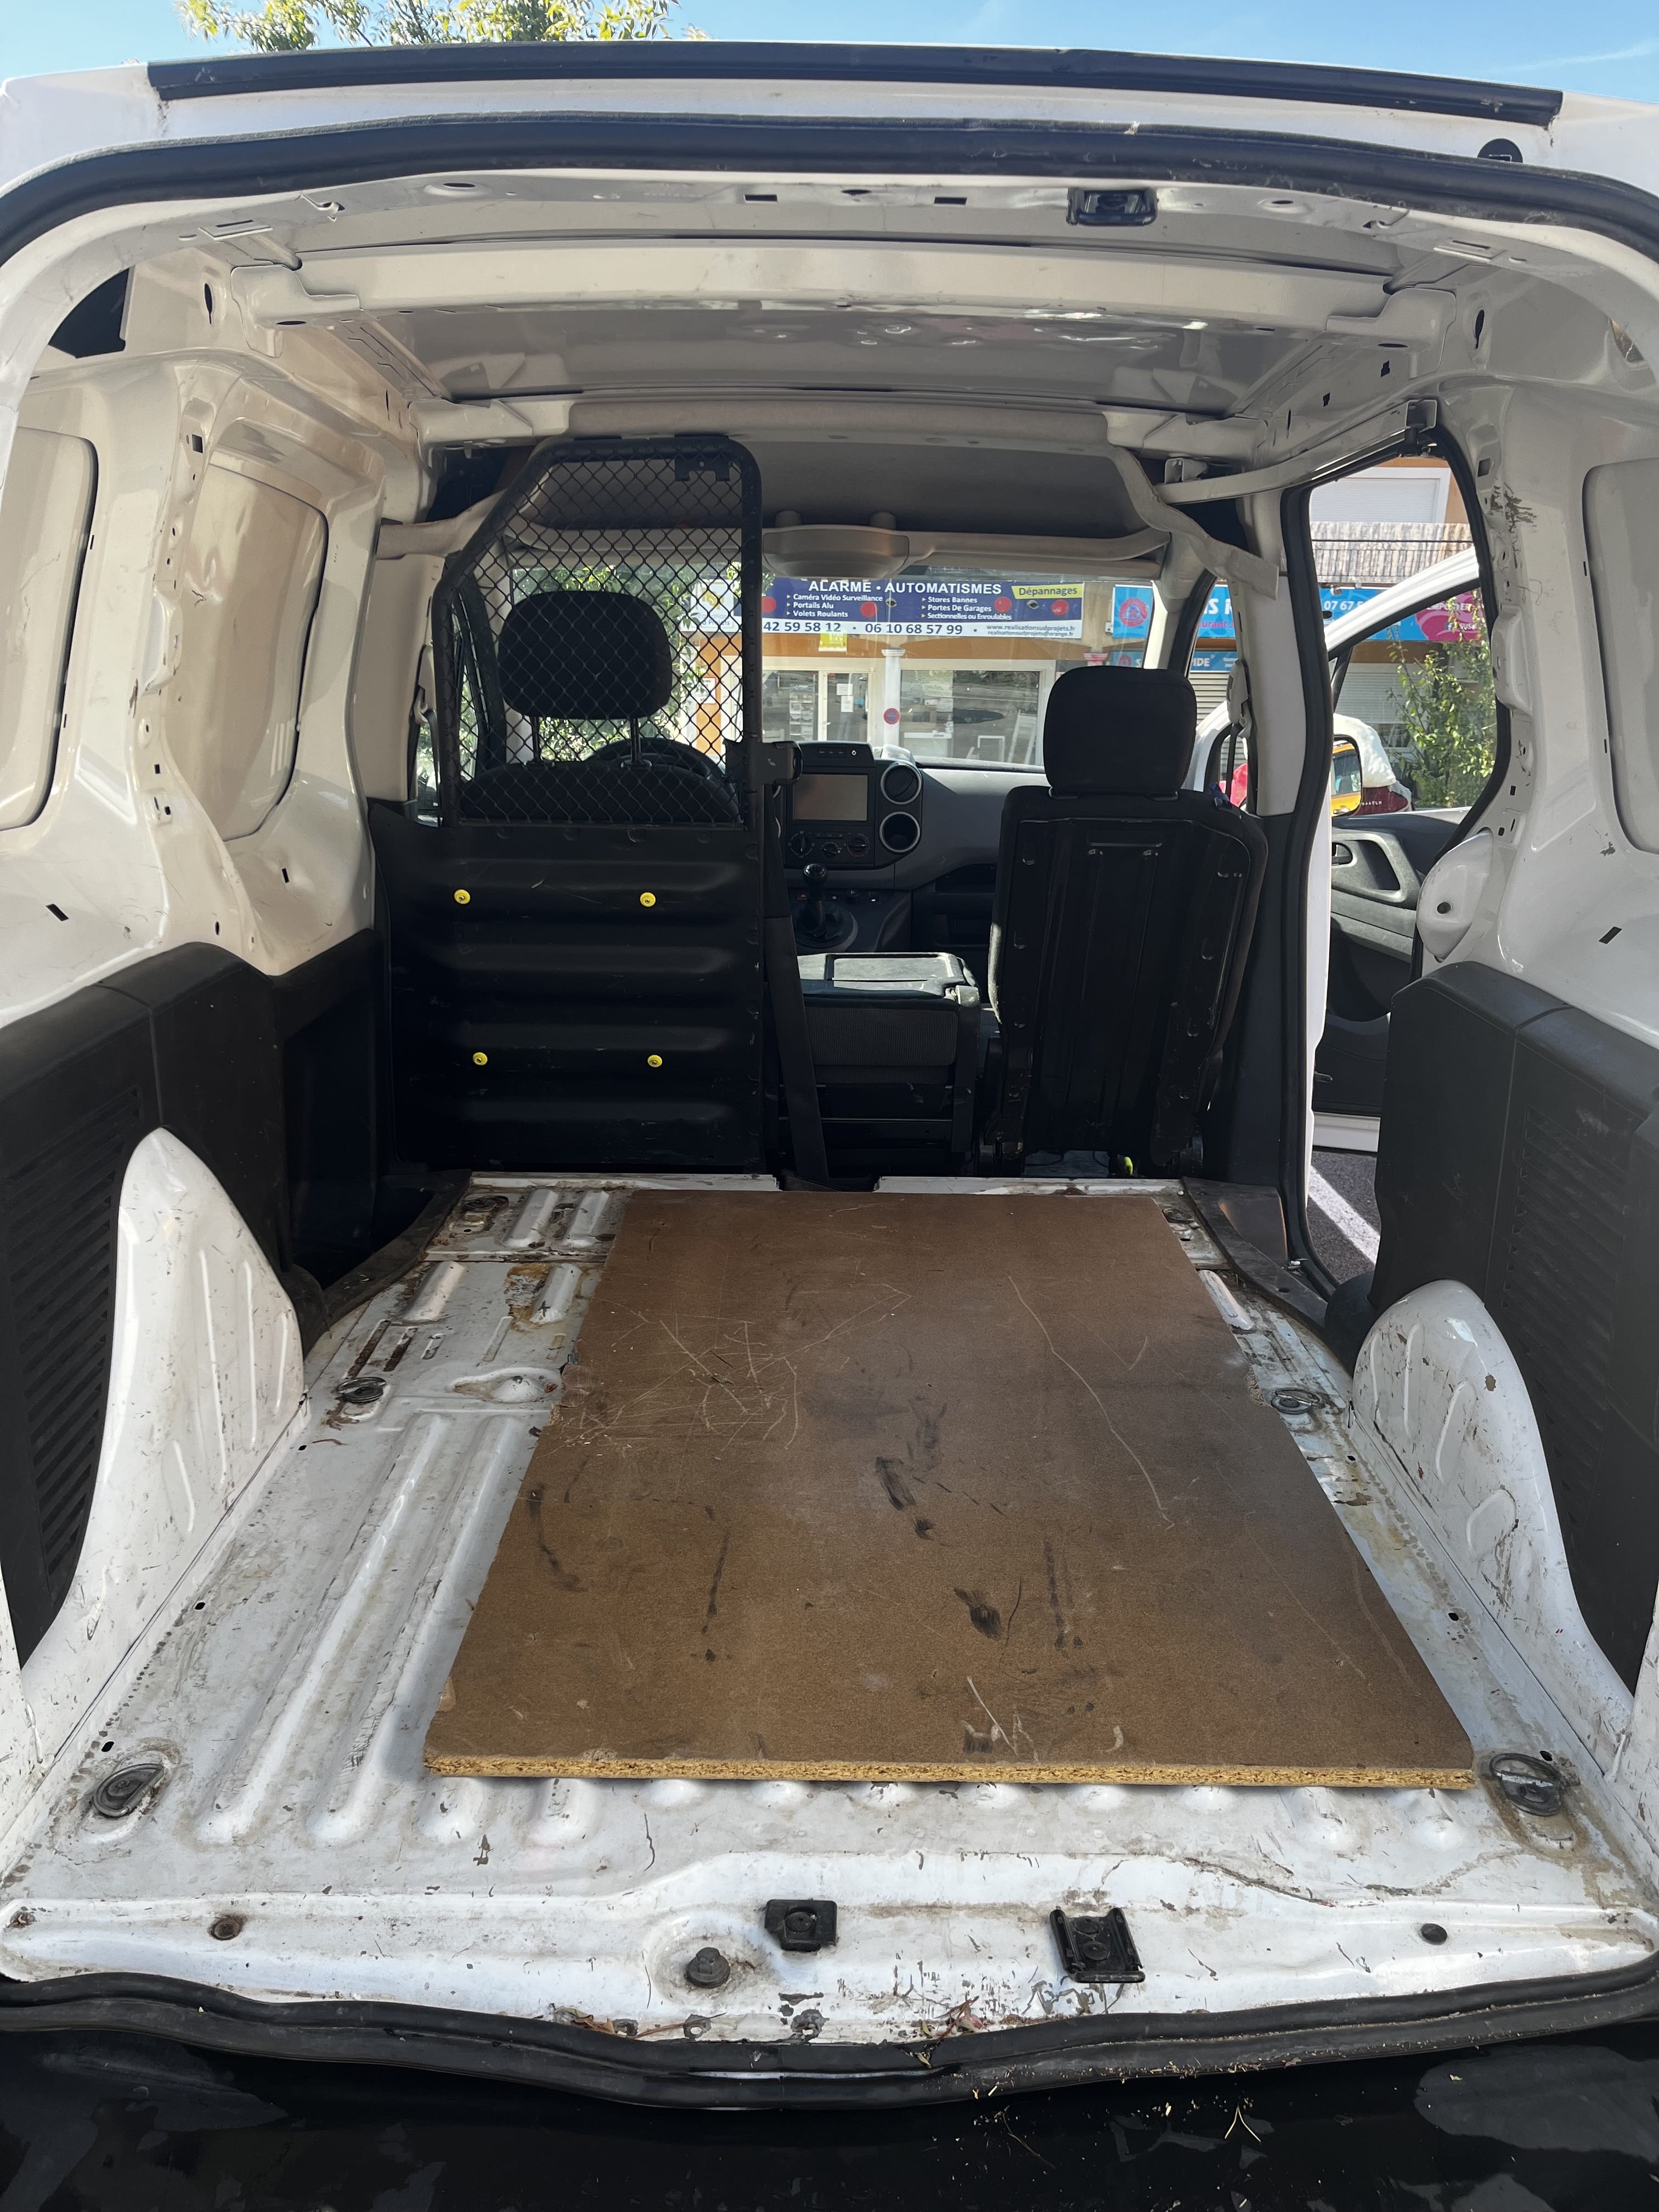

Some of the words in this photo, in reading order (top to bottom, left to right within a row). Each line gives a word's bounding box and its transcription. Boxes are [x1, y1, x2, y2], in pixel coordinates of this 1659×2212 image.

[809, 581, 872, 592] ALARME
[884, 583, 1002, 594] AUTOMATISMES
[1019, 587, 1077, 596] Dépannages
[1324, 600, 1339, 610] 07
[1340, 601, 1355, 611] 67
[764, 622, 780, 631] 42
[785, 622, 800, 631] 59
[805, 622, 821, 632] 58
[826, 623, 841, 632] 12
[865, 623, 882, 633] 06
[886, 624, 902, 633] 10
[906, 624, 922, 634] 68
[927, 624, 943, 634] 57
[946, 625, 962, 634] 99
[1192, 657, 1210, 667] IDE
